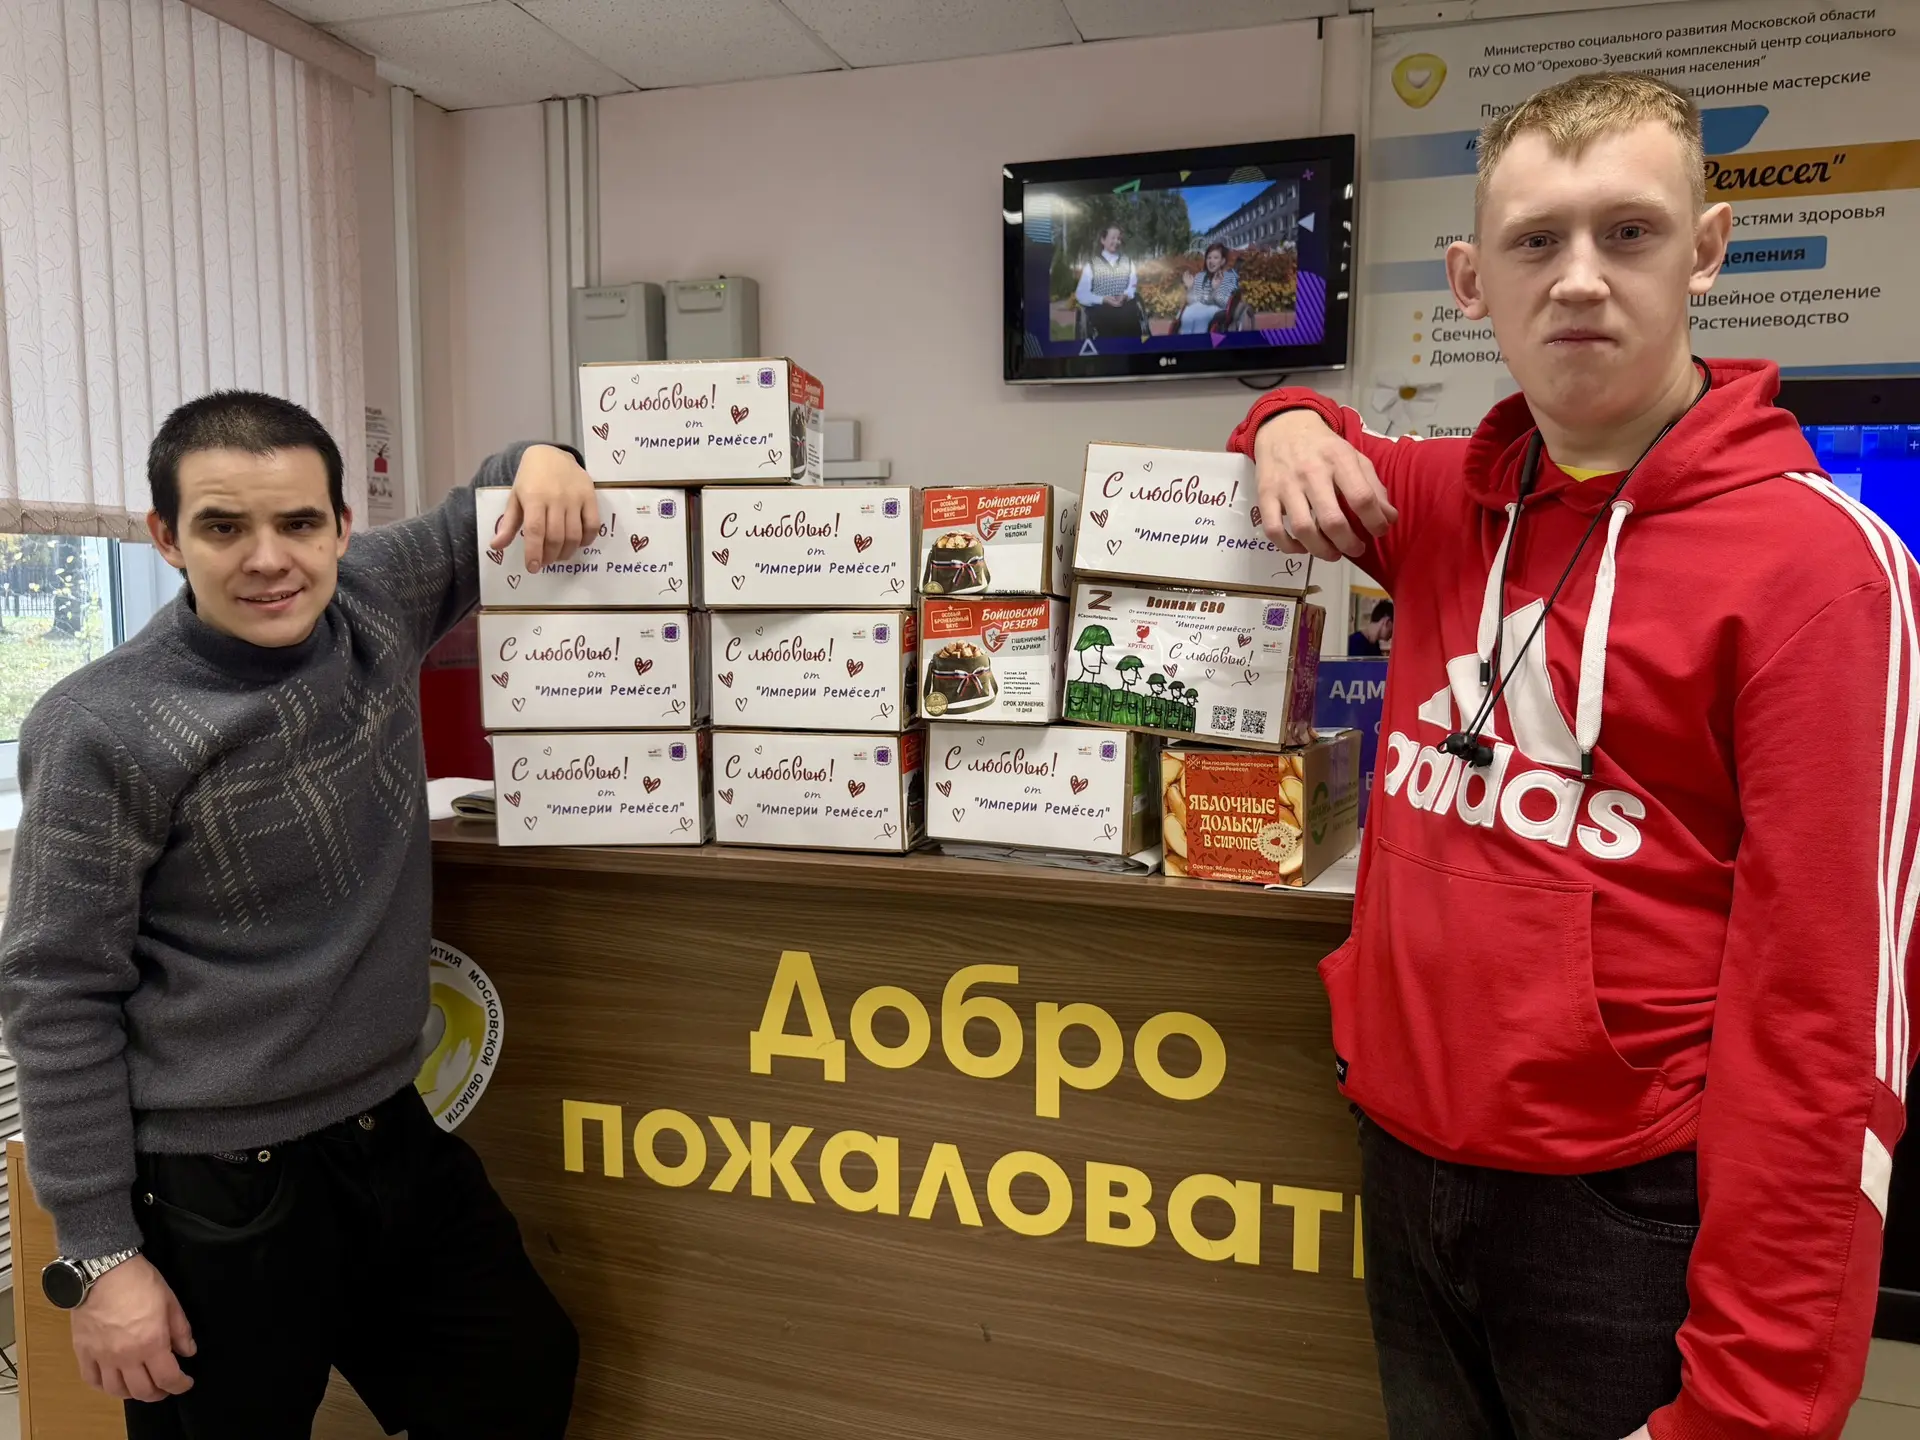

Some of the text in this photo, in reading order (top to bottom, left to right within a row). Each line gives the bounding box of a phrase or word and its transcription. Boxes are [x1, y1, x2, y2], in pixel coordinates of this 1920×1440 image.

[1484, 8, 1876, 58] Министерство социального развития Московской области
[1468, 66, 1490, 79] ГАУ
[1493, 63, 1511, 76] СО
[1513, 61, 1535, 74] МО
[1666, 39, 1757, 59] комплексный
[1760, 34, 1801, 50] центр
[1805, 26, 1896, 44] социального
[1481, 102, 1514, 119] Про
[1772, 69, 1871, 93] мастерские
[1798, 205, 1886, 226] здоровья
[1689, 285, 1882, 308] Швейное отделение
[1689, 311, 1849, 331] Растениеводство
[1431, 327, 1496, 343] Свечно
[599, 383, 717, 412] С любовью!
[685, 420, 704, 429] от
[1102, 471, 1239, 508] С любовью!
[996, 505, 1032, 520] РЕЗЕРВ
[1195, 516, 1216, 526] от
[720, 509, 840, 539] С любовью!
[583, 547, 602, 556] от
[807, 547, 826, 556] от
[1216, 534, 1280, 552] Ремёсе
[541, 562, 599, 575] мперии
[1200, 600, 1226, 614] СВО
[1002, 618, 1039, 631] РЕЗЕРВ
[500, 635, 620, 662] С любовью!
[725, 636, 833, 663] С любовью!
[1012, 643, 1041, 651] СУХАРИКИ
[1128, 642, 1155, 651] ХРУПКОЕ
[1169, 642, 1183, 660] С
[1185, 646, 1254, 667] любовью!
[588, 670, 606, 679] от
[803, 671, 821, 680] от
[1329, 680, 1386, 705] АДМ
[511, 754, 628, 782] С любовью!
[725, 754, 834, 783] С любовью!
[945, 745, 1057, 778] С любовью!
[598, 789, 616, 798] от
[804, 790, 822, 799] от
[1024, 785, 1042, 795] от
[1384, 731, 1646, 861] adidas
[1189, 794, 1276, 815] ЯБЛОЧНЫЕ
[1200, 815, 1264, 834] ДОЛЬКИ
[1214, 835, 1259, 851] СИРОПЕ
[430, 944, 499, 1124] ИТИЯ МОСКОВСКОЙ ОБЛАСТИ
[749, 949, 1227, 1118] Добро
[562, 1097, 1364, 1280] пожаловат
